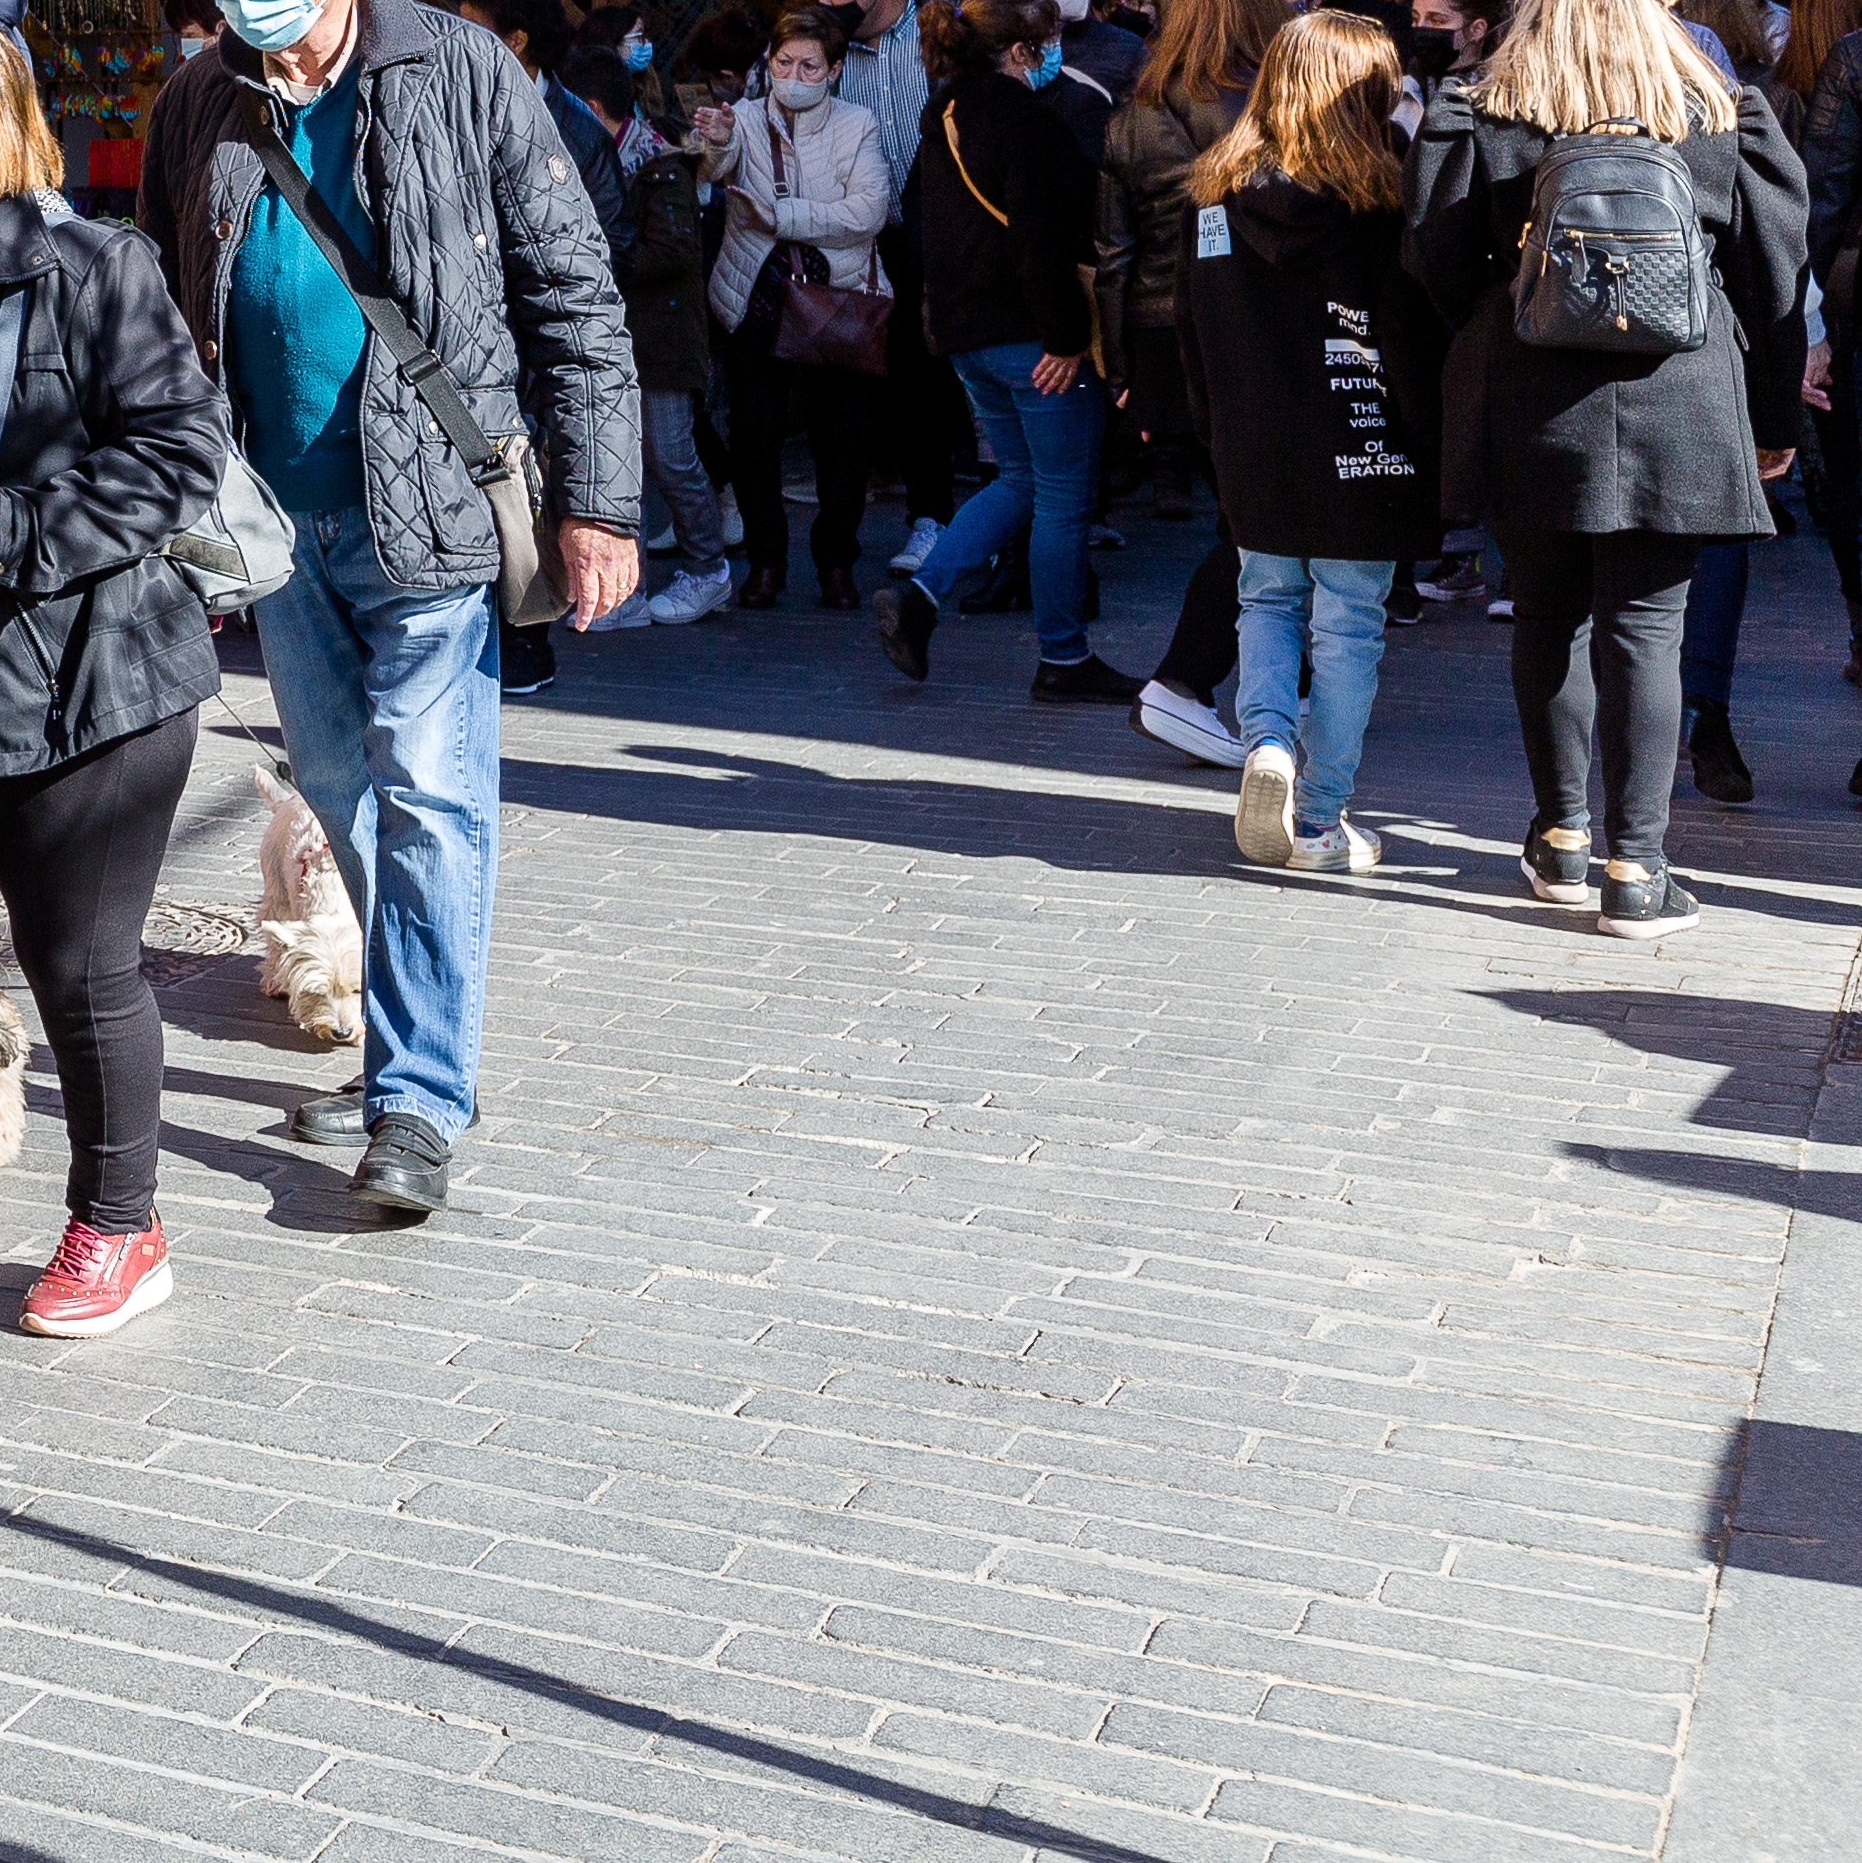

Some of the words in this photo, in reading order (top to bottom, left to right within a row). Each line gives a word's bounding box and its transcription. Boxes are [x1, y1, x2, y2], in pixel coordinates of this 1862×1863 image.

[1203, 211, 1218, 225] WE
[1350, 402, 1381, 415] THE
[1349, 415, 1387, 428] voice
[1335, 454, 1372, 468] New
[1377, 452, 1408, 465] Gen
[1338, 463, 1415, 480] ERATION
